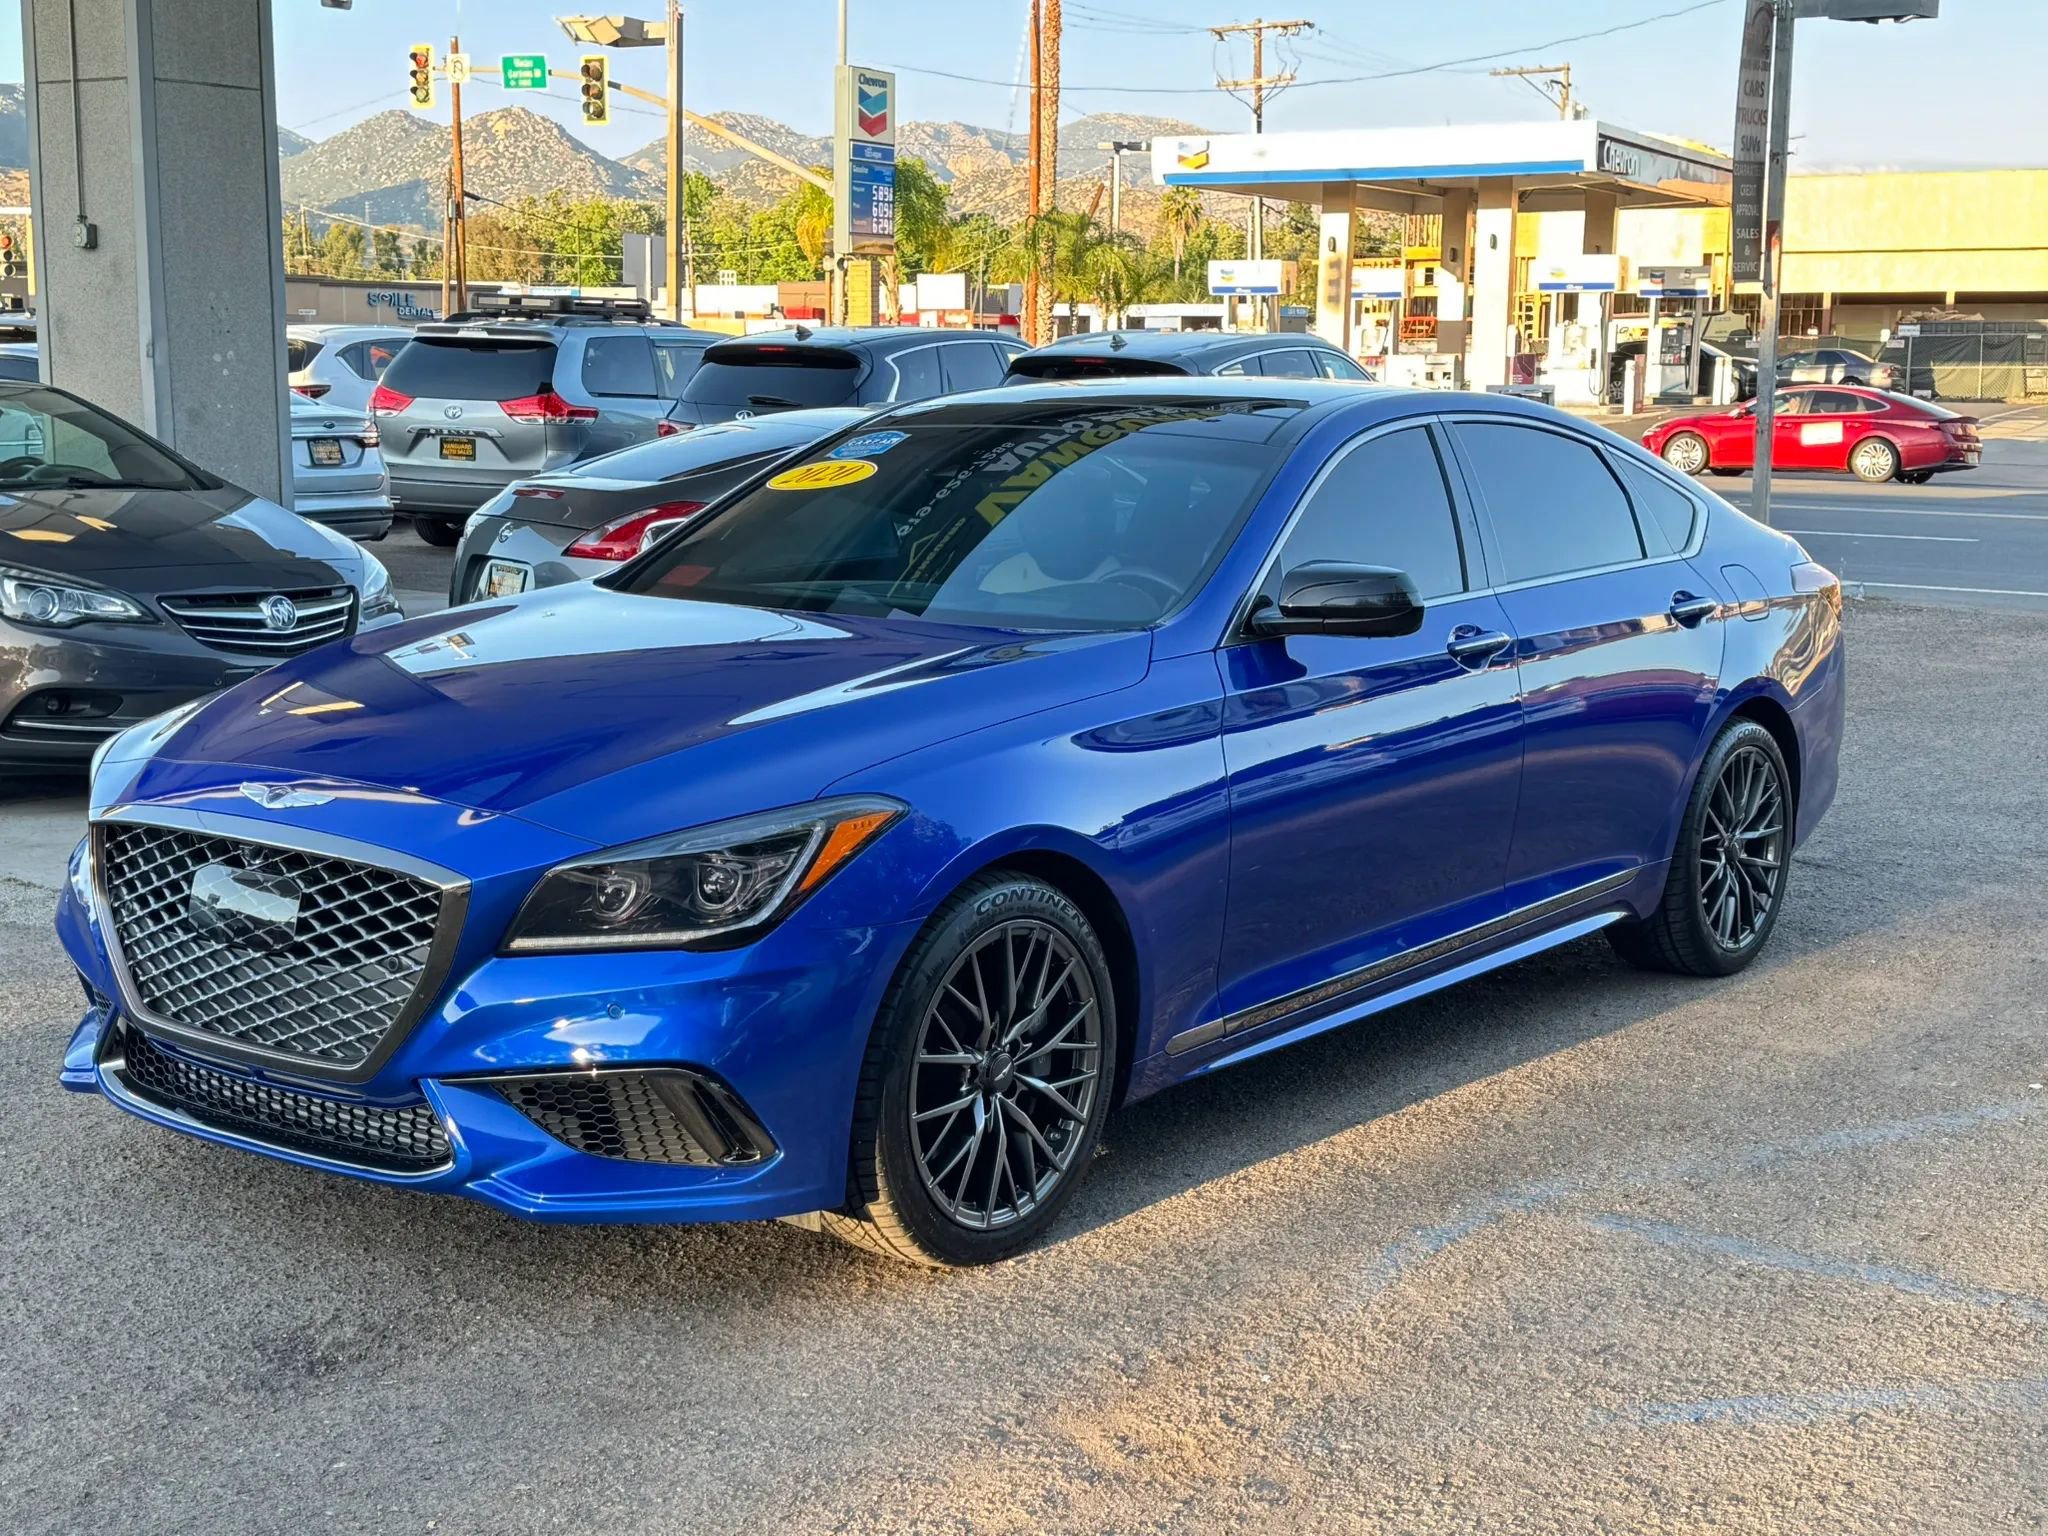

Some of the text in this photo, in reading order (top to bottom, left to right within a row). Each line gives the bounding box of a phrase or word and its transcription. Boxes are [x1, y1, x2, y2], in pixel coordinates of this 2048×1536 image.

[859, 73, 887, 89] Chevron
[1743, 79, 1765, 98] CARS
[1738, 106, 1768, 126] TRUCKS
[1741, 135, 1761, 153] SUVs
[1603, 139, 1639, 177] Chevron
[1736, 228, 1760, 239] SALES
[1744, 245, 1751, 256] &
[1733, 261, 1758, 273] SERVIC
[399, 306, 433, 317] DENTAL
[443, 442, 473, 450] VANGUARD
[776, 464, 866, 485] 2020
[975, 886, 1096, 940] CONTINEN
